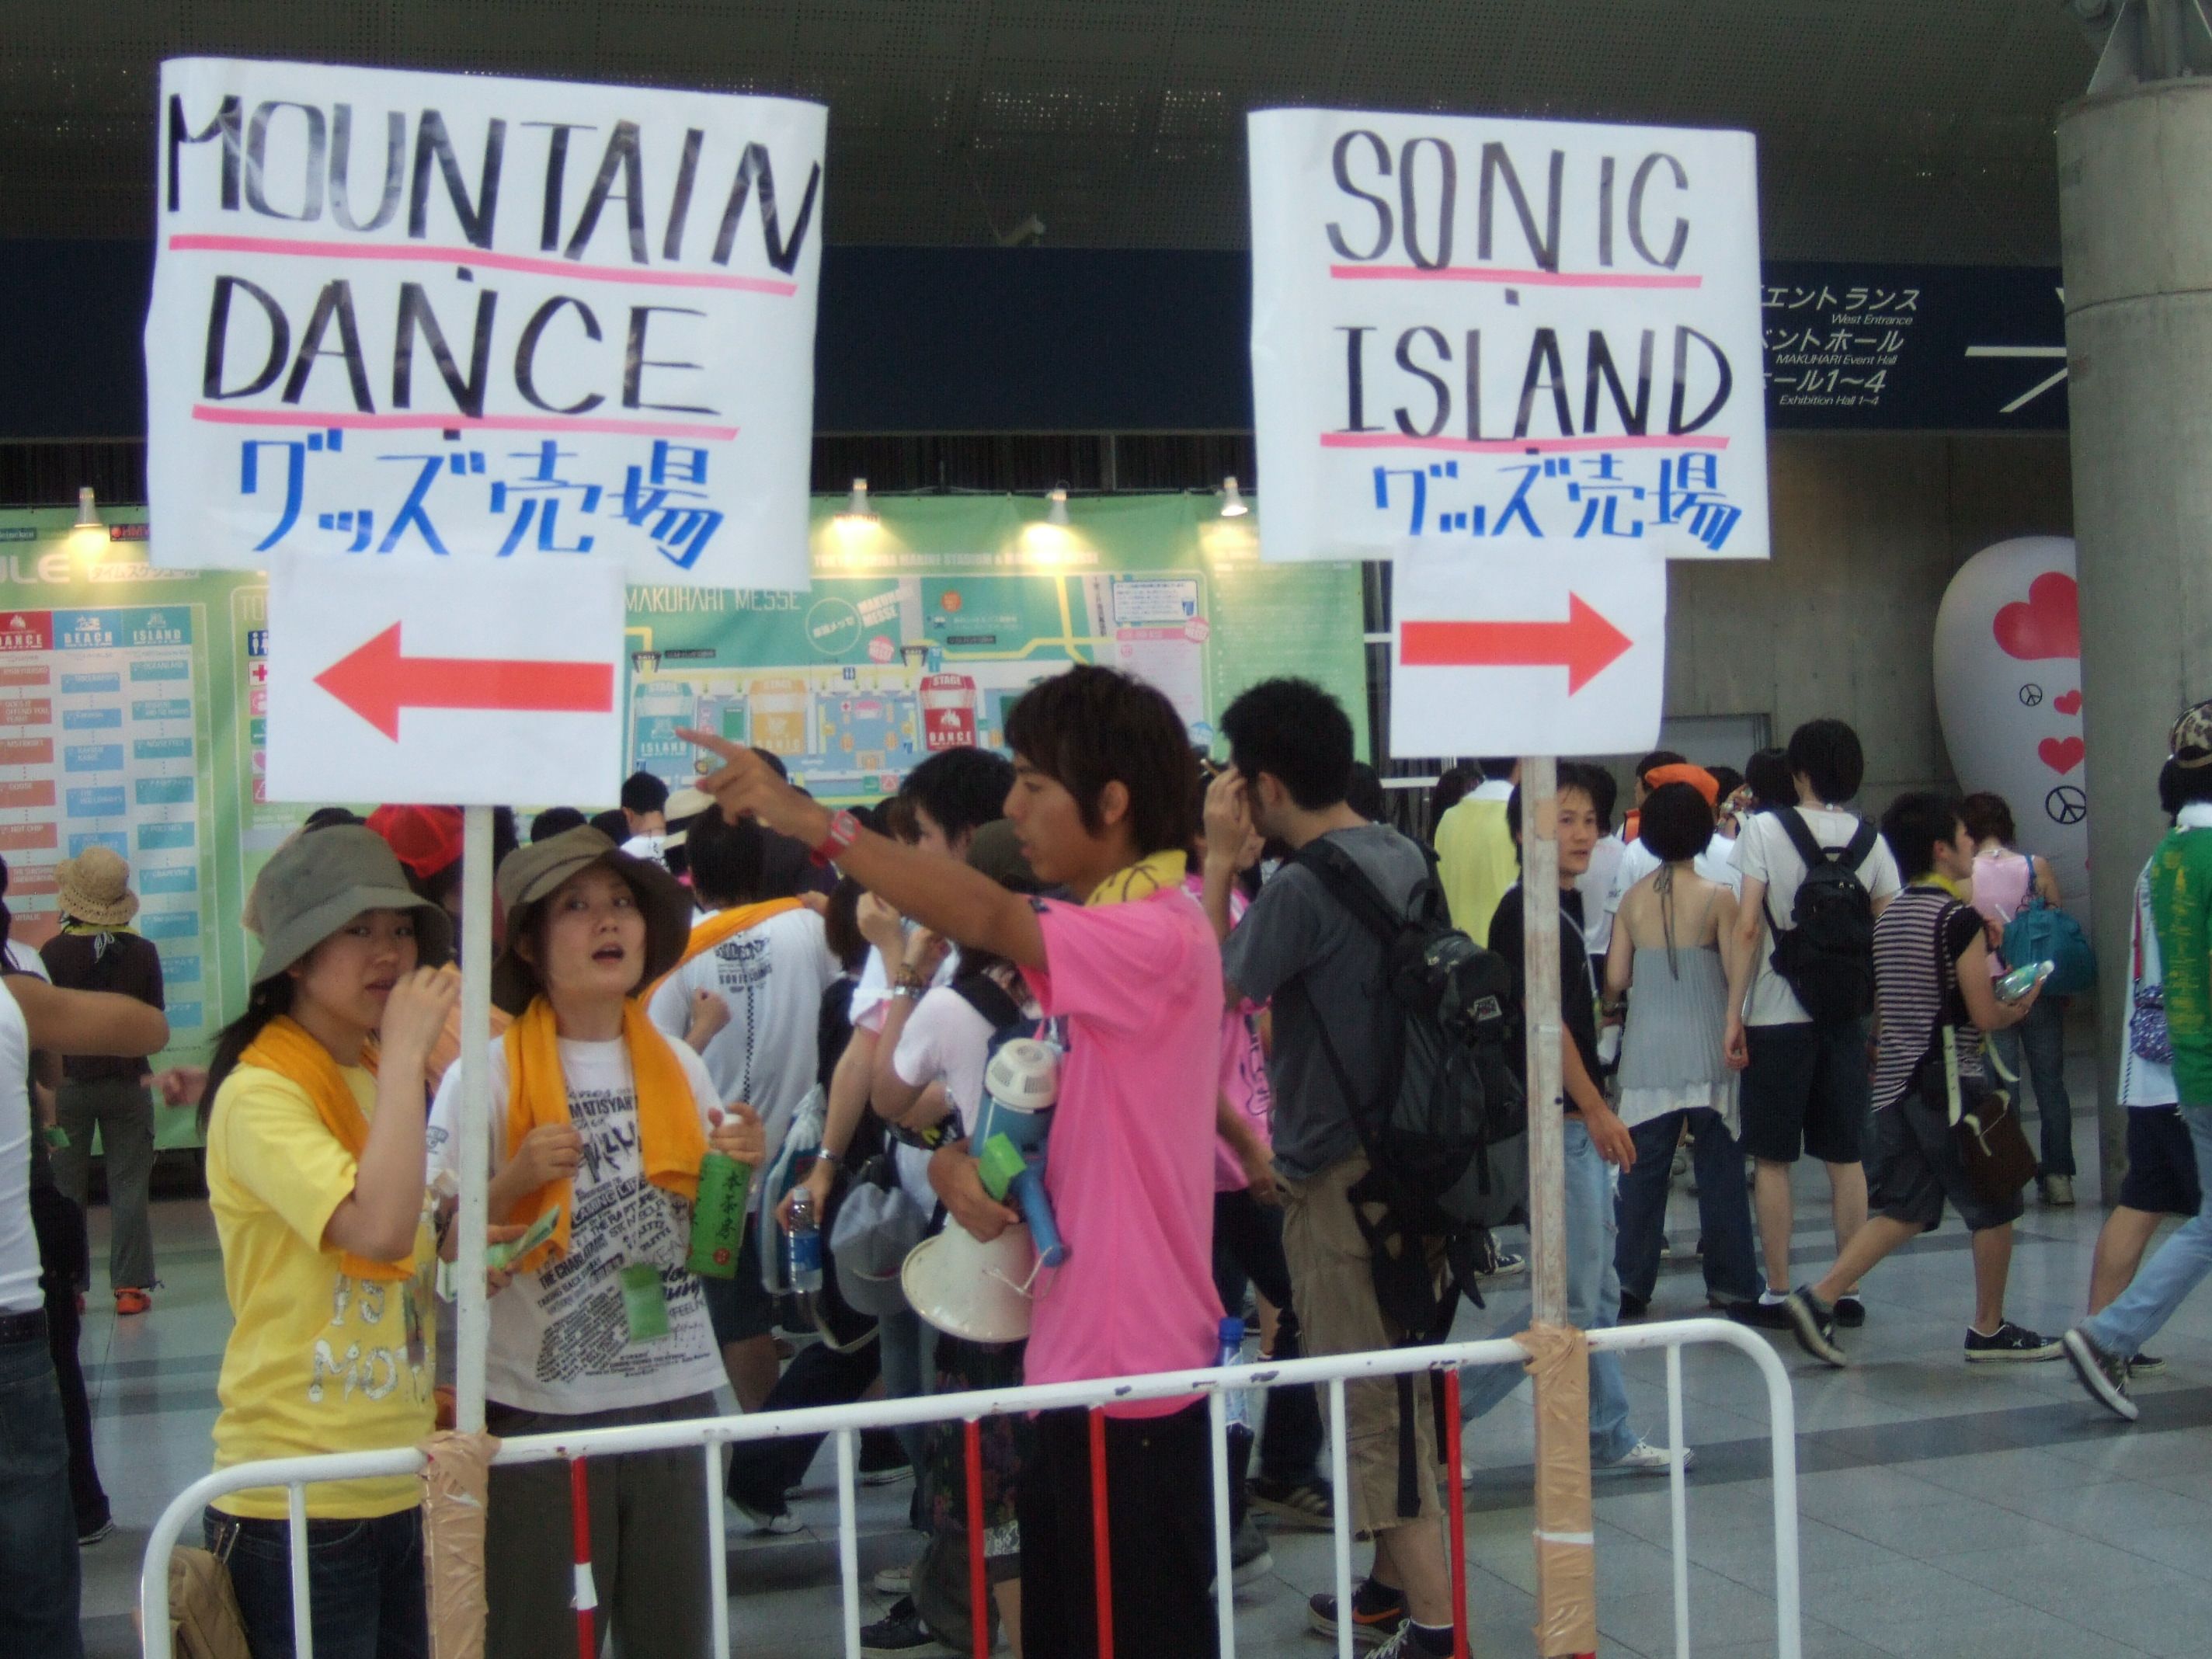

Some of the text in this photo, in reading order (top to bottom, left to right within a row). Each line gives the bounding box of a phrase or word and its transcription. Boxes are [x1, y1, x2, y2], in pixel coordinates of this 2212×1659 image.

[168, 93, 821, 276] MOUNTAIN
[1326, 130, 1689, 273] SONIC
[203, 275, 721, 419] DANCE
[1776, 354, 1897, 365] MAKUHARI Event Hall
[1831, 314, 1913, 325] West Entrance
[1333, 325, 1733, 441] ISLAND
[1779, 395, 1833, 405] Exhibition
[1835, 395, 1856, 405] Hall
[241, 429, 724, 571] グッズ売場
[1373, 453, 1742, 551] グッズ売場
